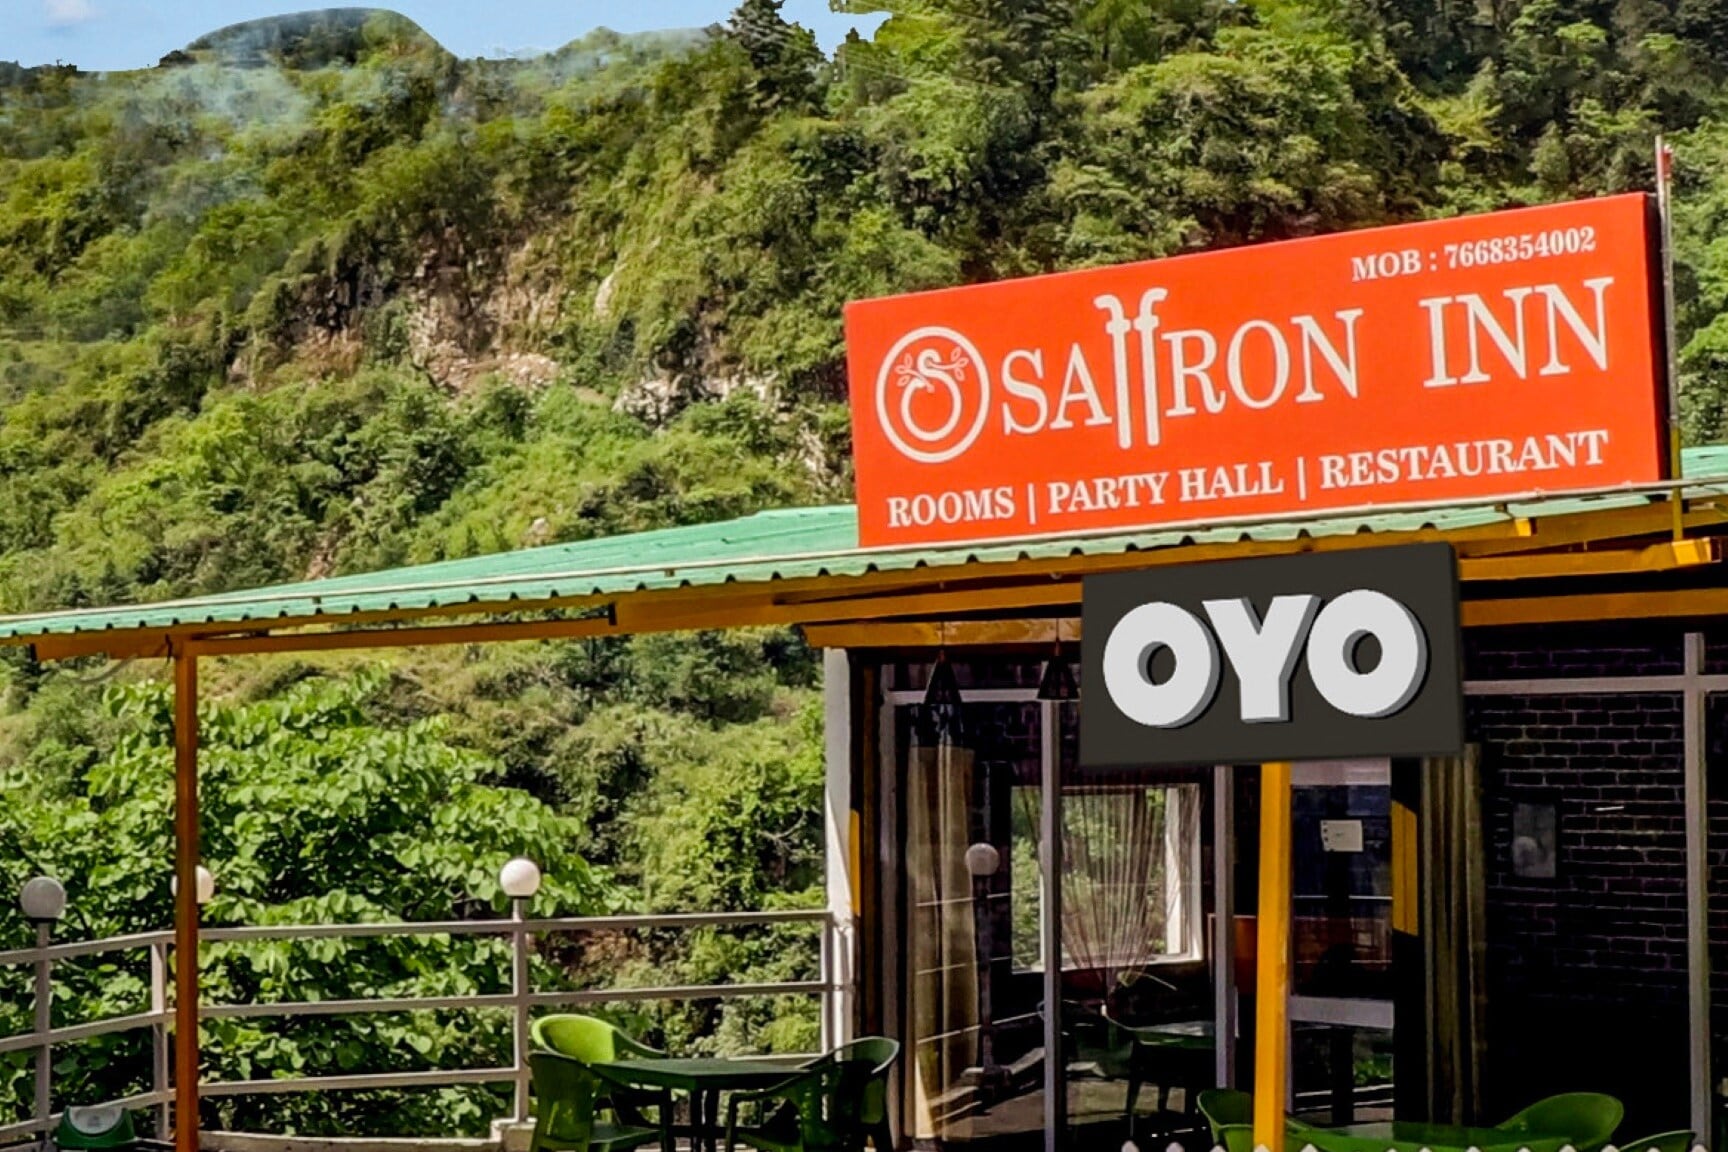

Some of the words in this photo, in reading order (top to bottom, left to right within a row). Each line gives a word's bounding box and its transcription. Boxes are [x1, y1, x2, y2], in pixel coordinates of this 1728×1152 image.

[1351, 249, 1422, 282] MOB
[1444, 226, 1596, 269] 7668354002
[1418, 276, 1614, 389] INN
[887, 486, 1015, 528] ROOMS
[1047, 471, 1169, 514] PARTY
[1178, 461, 1284, 502] HALL
[1319, 429, 1609, 489] RESTAURANT
[1102, 588, 1429, 728] OYO
